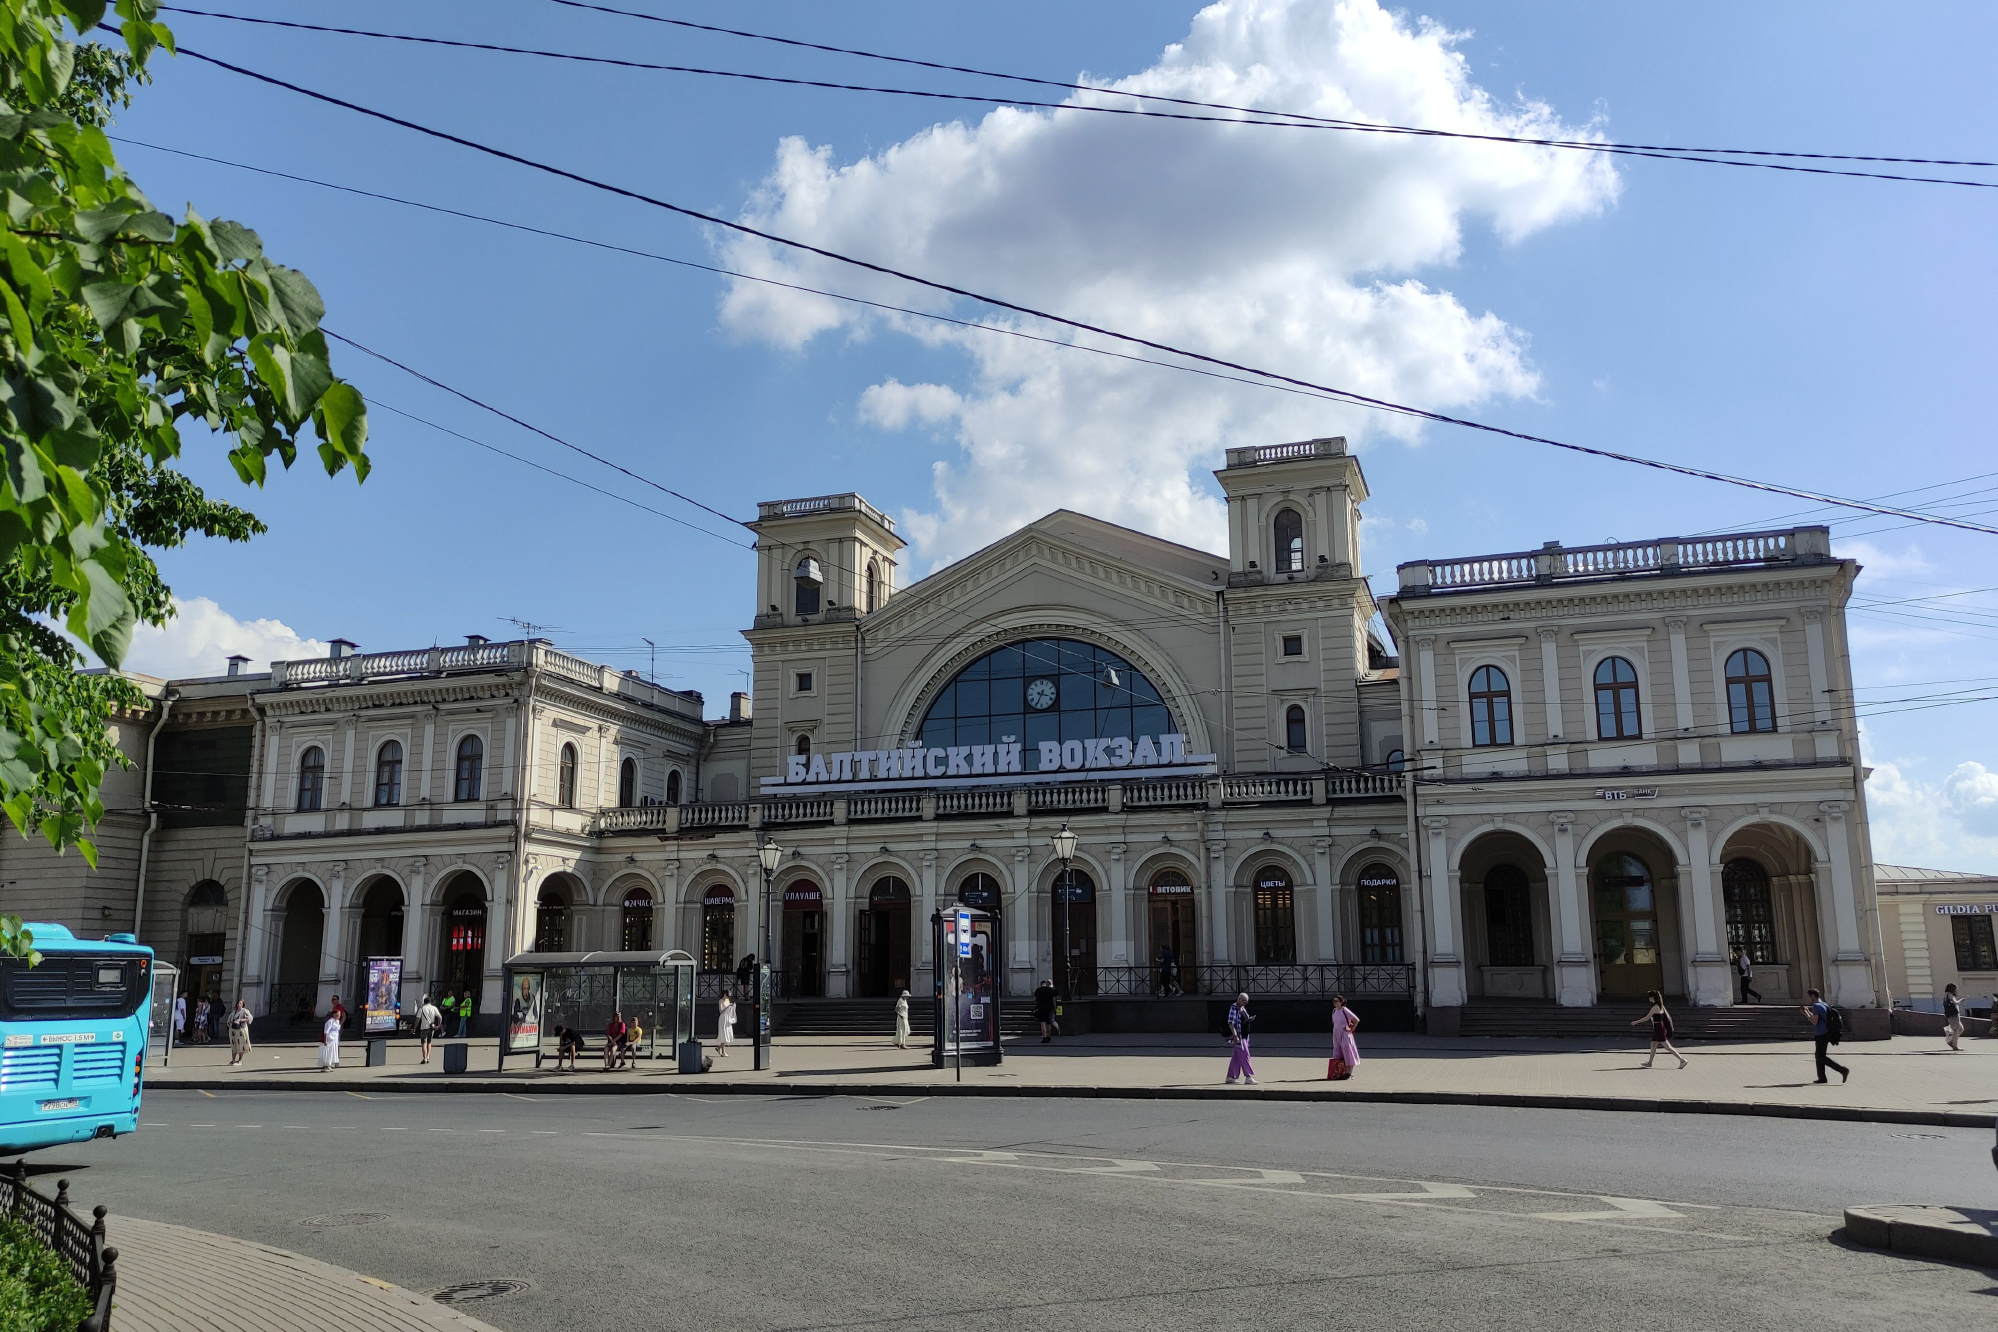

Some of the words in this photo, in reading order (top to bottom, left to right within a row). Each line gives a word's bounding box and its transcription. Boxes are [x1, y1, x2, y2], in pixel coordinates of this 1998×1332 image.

[786, 735, 1022, 782] БАЛТИЙСКИЙ
[1038, 733, 1187, 772] ВОКЗАЛ
[1605, 790, 1627, 800] ВТБ
[1260, 880, 1286, 888] ЦВЕТЫ
[1361, 879, 1397, 887] ПОДАРКИ
[704, 896, 735, 905] ШАВЕРМА
[1935, 904, 1981, 914] GILDIA
[48, 1035, 72, 1043] ВЫНОС
